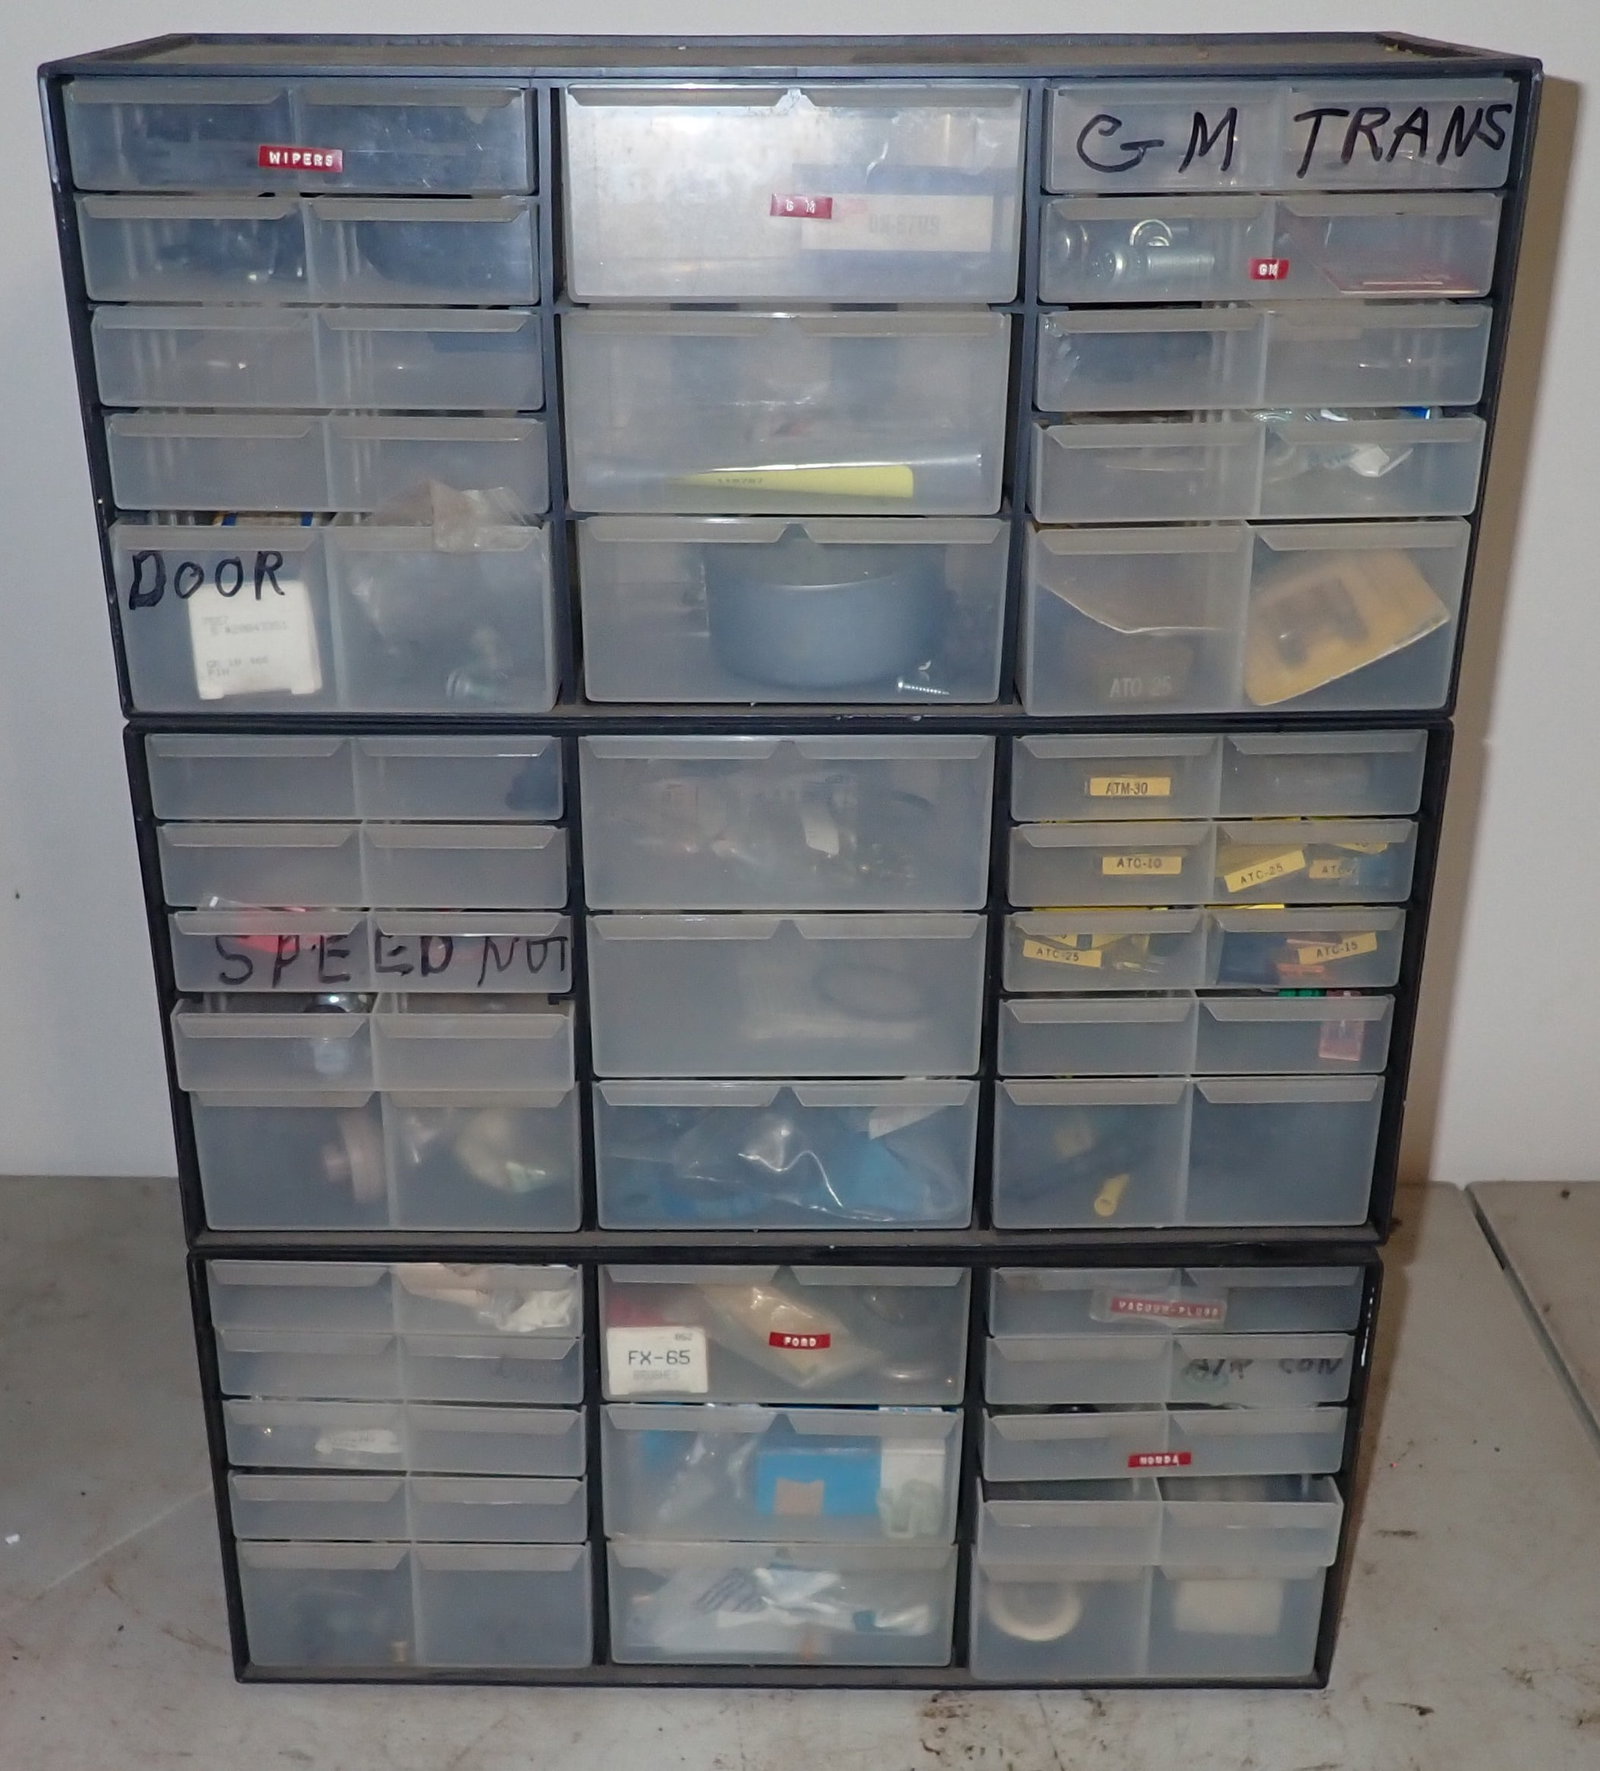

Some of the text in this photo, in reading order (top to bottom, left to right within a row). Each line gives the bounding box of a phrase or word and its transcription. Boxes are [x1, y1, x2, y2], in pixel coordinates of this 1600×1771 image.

[1294, 103, 1513, 179] TRANS
[268, 150, 334, 168] WIPERS
[128, 549, 286, 611] DOOR
[1105, 781, 1149, 796] ATM-30
[1239, 862, 1284, 885] ATC-25
[1036, 946, 1080, 963] ATC-25
[1316, 941, 1358, 959] ATC-15
[214, 931, 454, 989] SPEED
[784, 1336, 817, 1347] FORD
[627, 1349, 691, 1366] FX-65
[1139, 1454, 1179, 1466] HONDA
